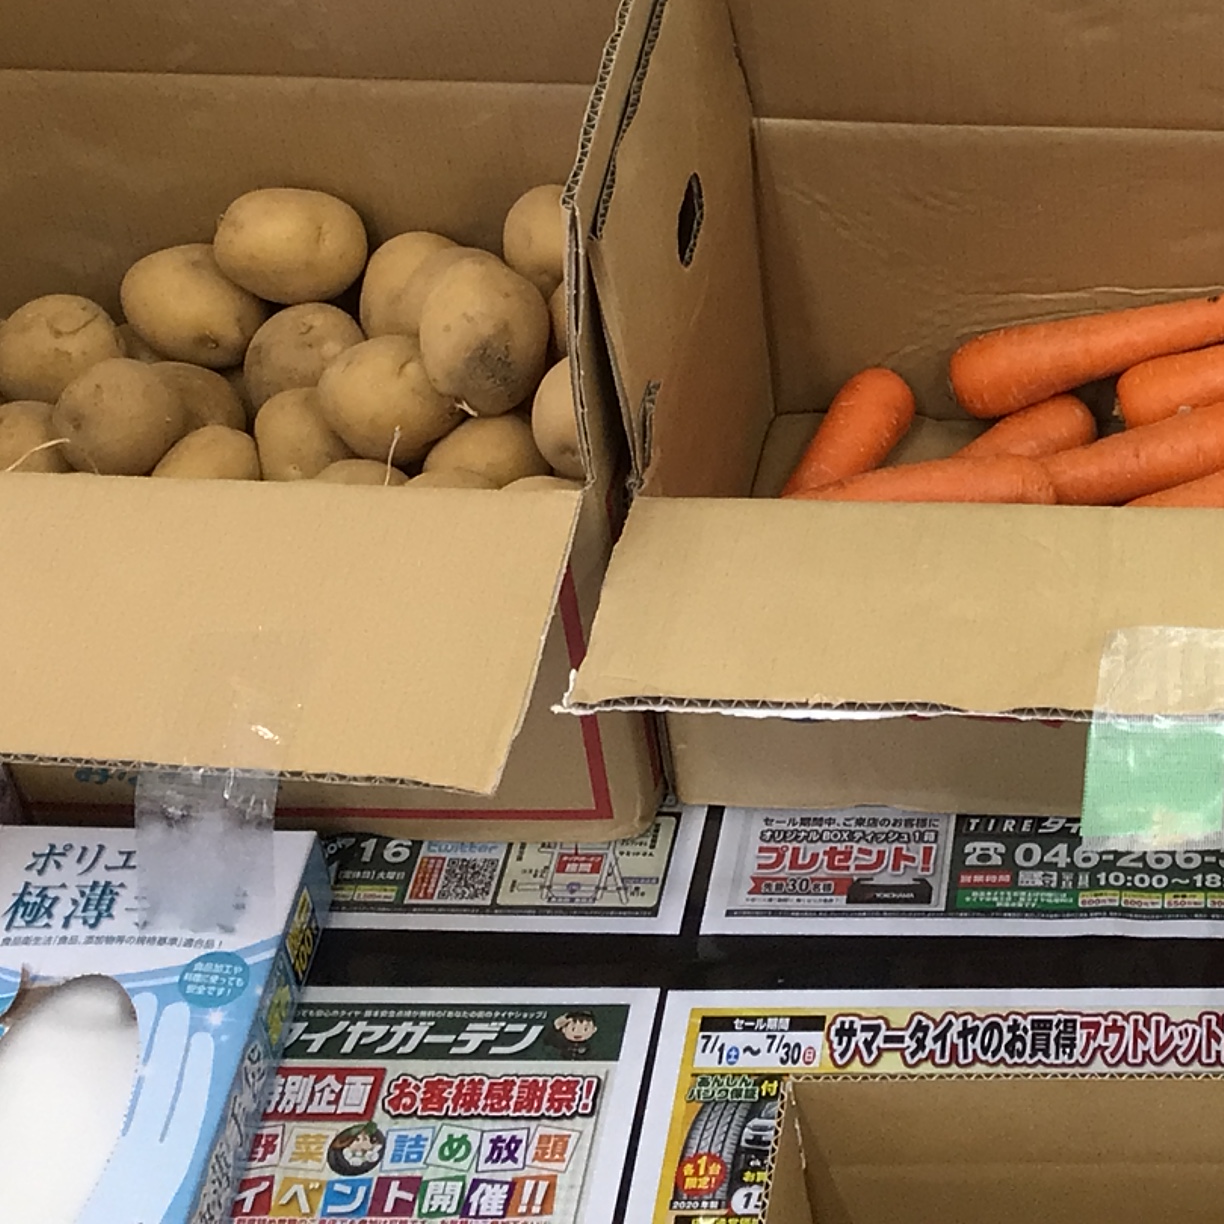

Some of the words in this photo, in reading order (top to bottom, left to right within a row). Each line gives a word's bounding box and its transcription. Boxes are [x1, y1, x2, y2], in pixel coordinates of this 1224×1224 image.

[968, 818, 1034, 833] TIRE
[756, 845, 935, 873] プレゼント!
[733, 1018, 789, 1031] セール期間
[387, 1078, 597, 1117] お客様感謝祭!
